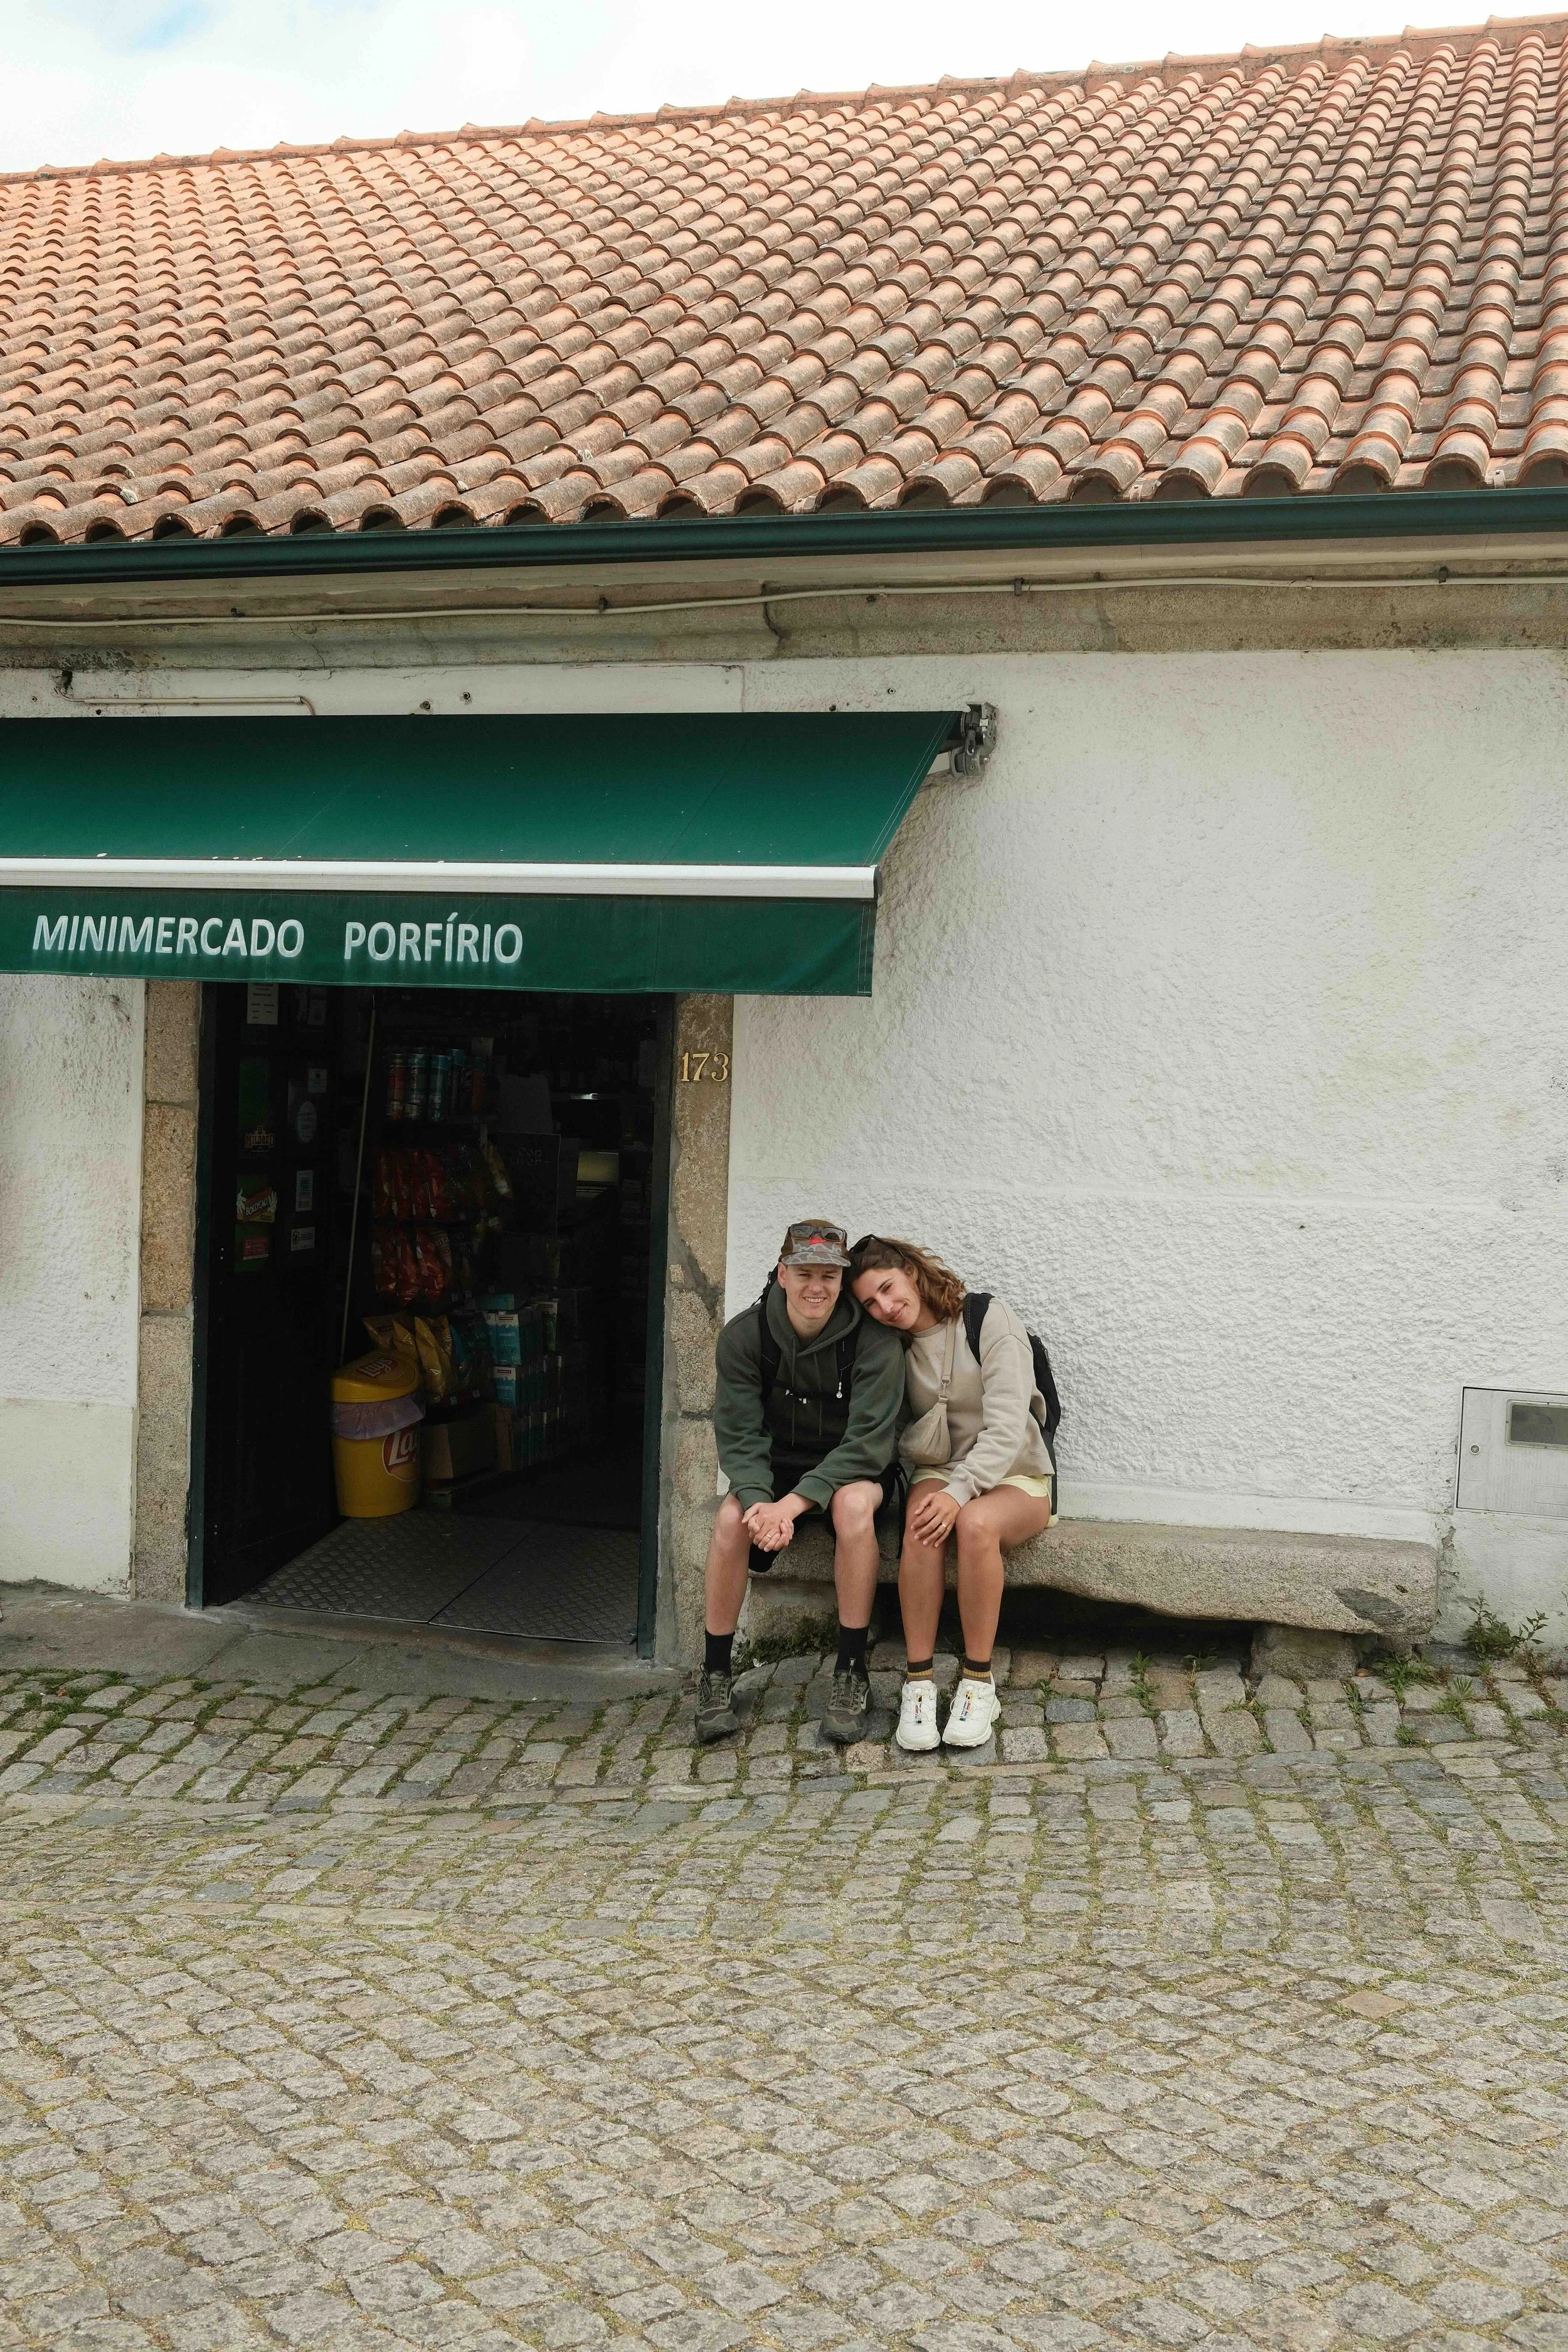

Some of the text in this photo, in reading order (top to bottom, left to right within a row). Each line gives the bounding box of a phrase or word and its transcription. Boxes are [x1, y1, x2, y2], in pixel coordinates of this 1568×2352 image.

[32, 912, 524, 963] MINIMERCADO PORFÍRIO
[681, 1052, 729, 1082] 173
